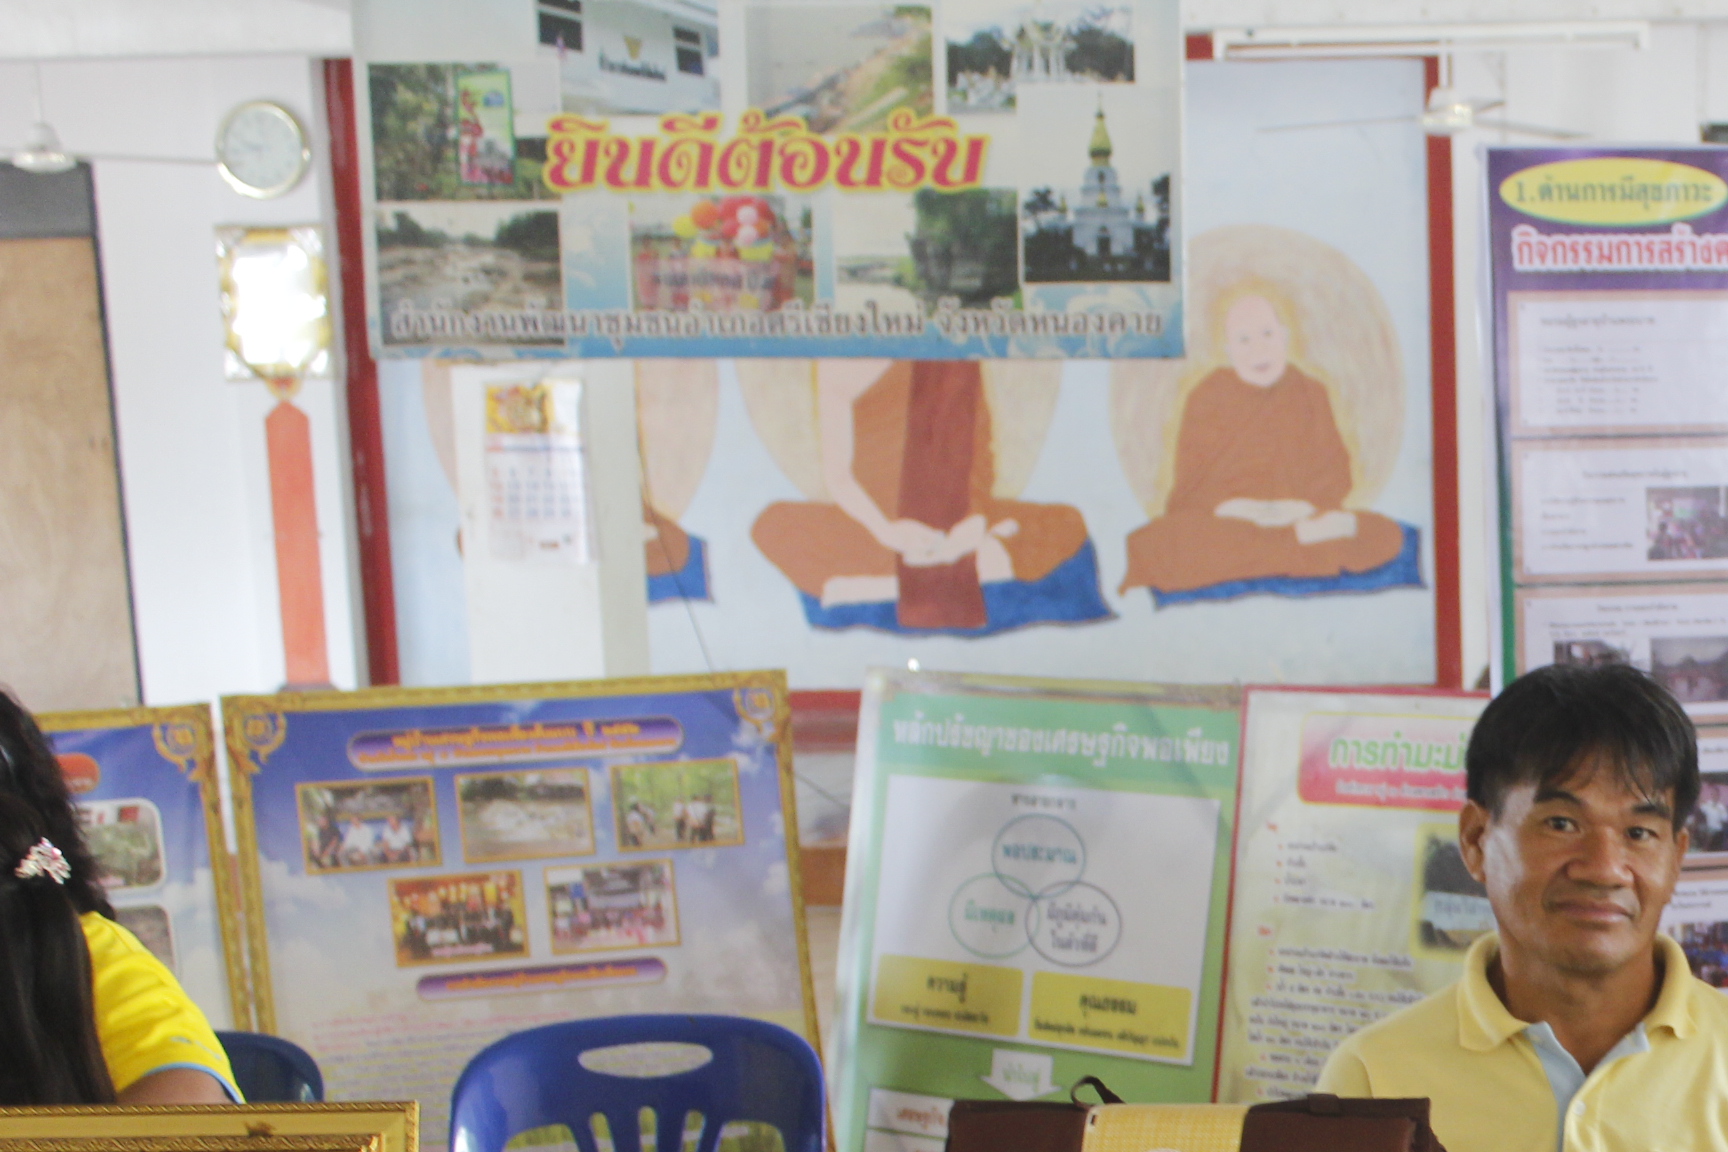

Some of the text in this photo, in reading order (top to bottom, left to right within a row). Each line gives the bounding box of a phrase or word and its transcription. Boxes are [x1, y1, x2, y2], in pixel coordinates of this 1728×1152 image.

[543, 108, 990, 193] ยินดีต้อนรับ
[391, 297, 1164, 354] สำนักงานพัฒนาชุมชนอำเภอศรีเชียงใหม่ จังหวัดหนองคาย
[893, 710, 1230, 767] หลักปรัชญาของเศรษฐกิจพอเพียง
[1332, 731, 1467, 770] การทำมะม่
